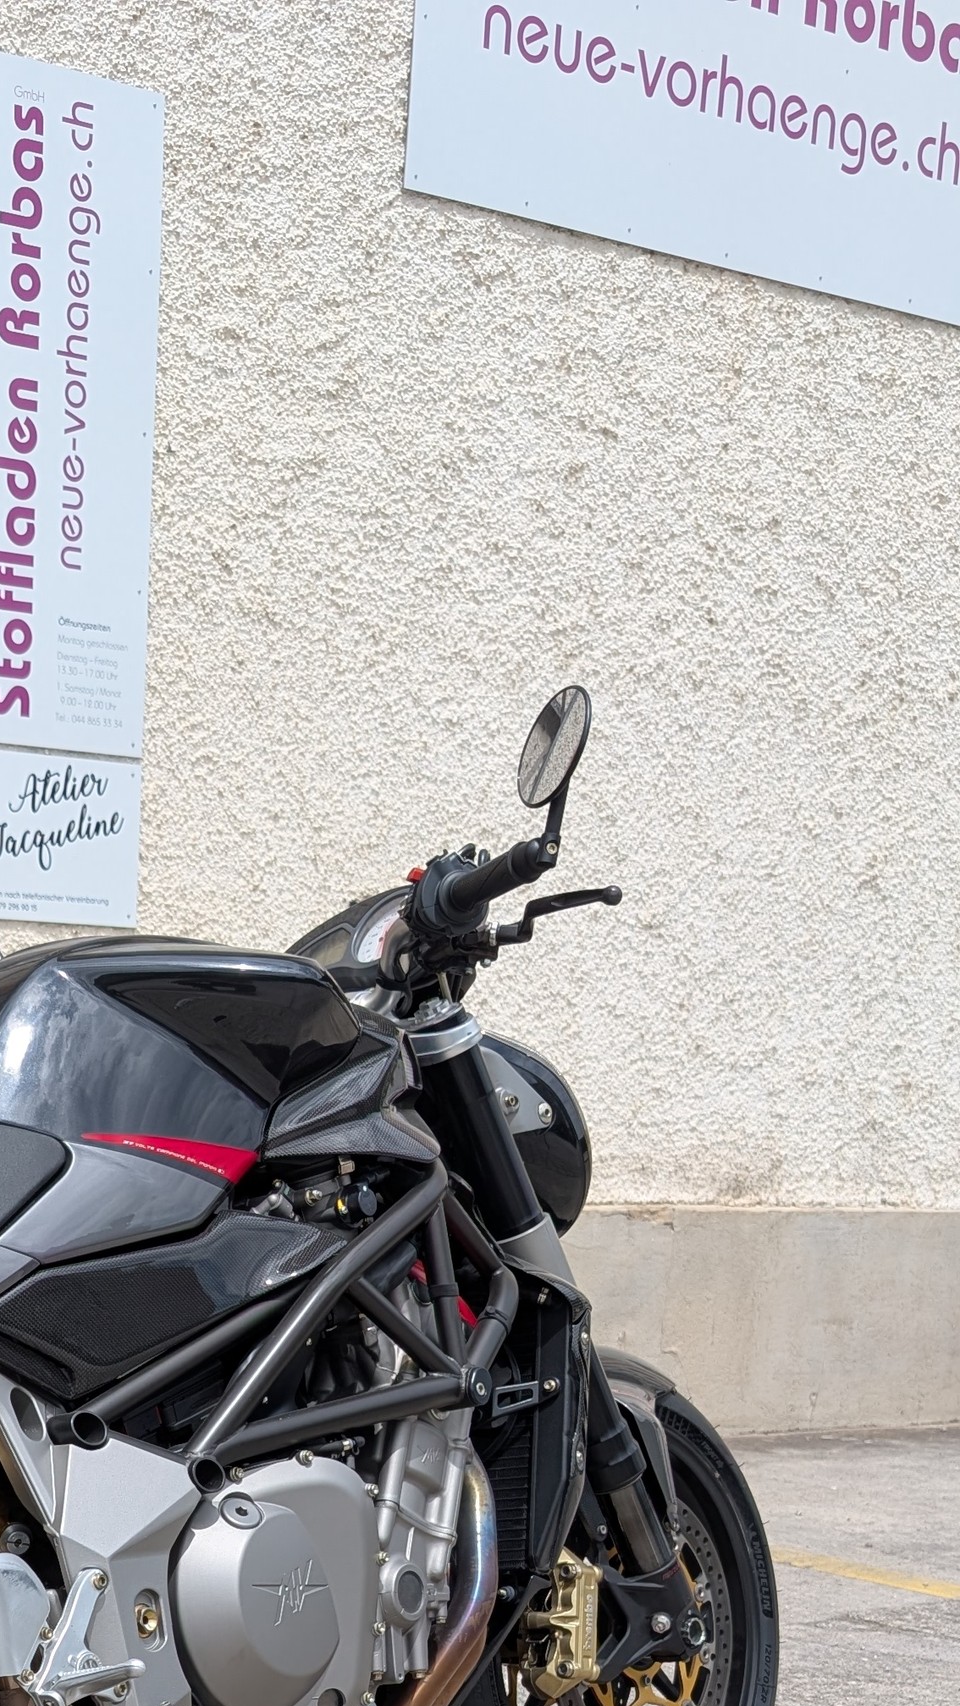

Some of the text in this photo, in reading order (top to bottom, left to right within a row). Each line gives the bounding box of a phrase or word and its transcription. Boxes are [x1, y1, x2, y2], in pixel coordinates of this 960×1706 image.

[13, 85, 46, 103] GmbH
[483, 4, 960, 186] neue-vorhaenge.ch
[60, 101, 101, 571] neue-vorhaenge.ch
[58, 616, 112, 632] Öffnungszeiten
[58, 634, 129, 652] Montag geschlossen
[57, 651, 88, 665] Dienstag
[94, 656, 119, 670] Freitag
[106, 671, 118, 681] Uhr
[64, 683, 95, 697] Samstag
[99, 688, 122, 698] Monat
[105, 702, 117, 712] Uhr
[8, 764, 109, 813] Atelier
[3, 891, 21, 900] nach
[21, 892, 65, 903] telefonischer
[64, 895, 110, 907] Vereinbarung
[20, 903, 30, 912] 90
[751, 1538, 774, 1616] MICHELIN
[761, 1643, 772, 1685] 120/70
[758, 1686, 767, 1704] ZR
